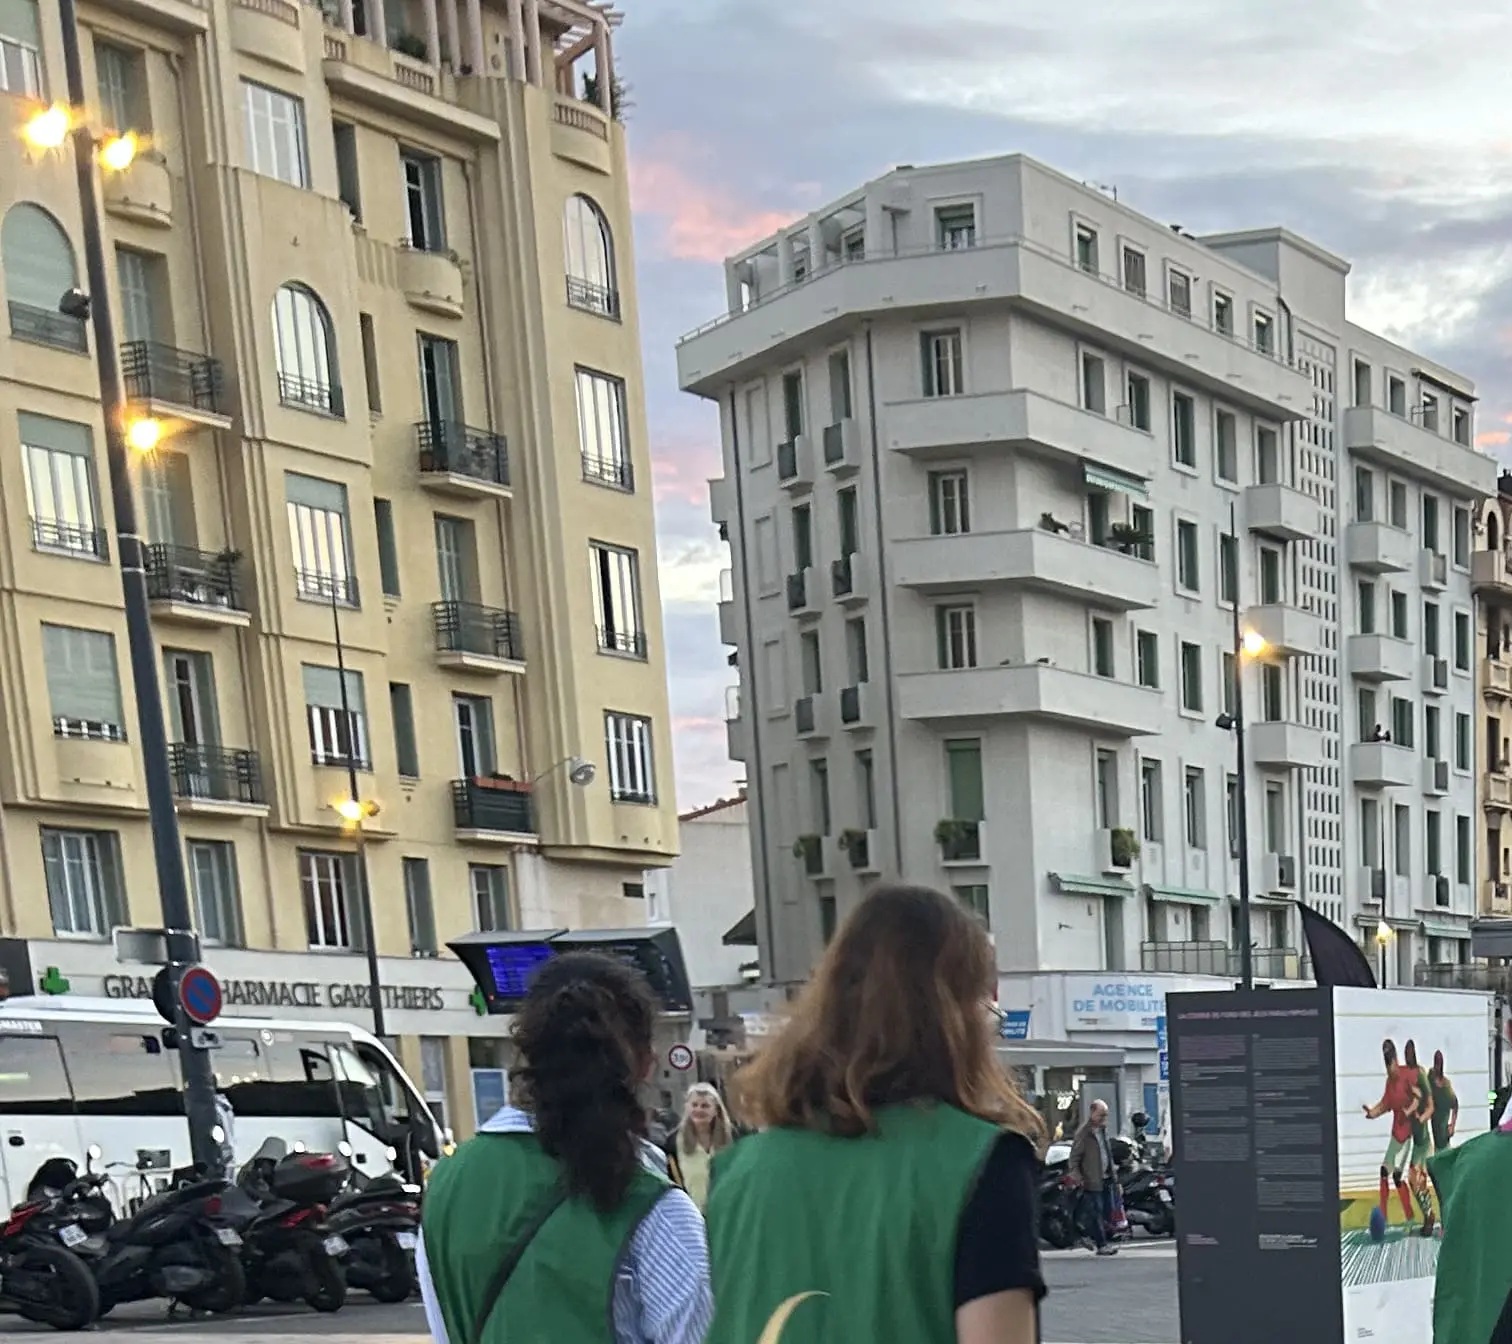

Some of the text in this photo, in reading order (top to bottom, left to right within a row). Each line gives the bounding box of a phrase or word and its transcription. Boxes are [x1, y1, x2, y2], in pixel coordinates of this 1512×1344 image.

[103, 974, 444, 1011] GRA HARMACIE GAR THIERS
[1092, 983, 1153, 997] AGENCE
[1073, 999, 1095, 1013] DE
